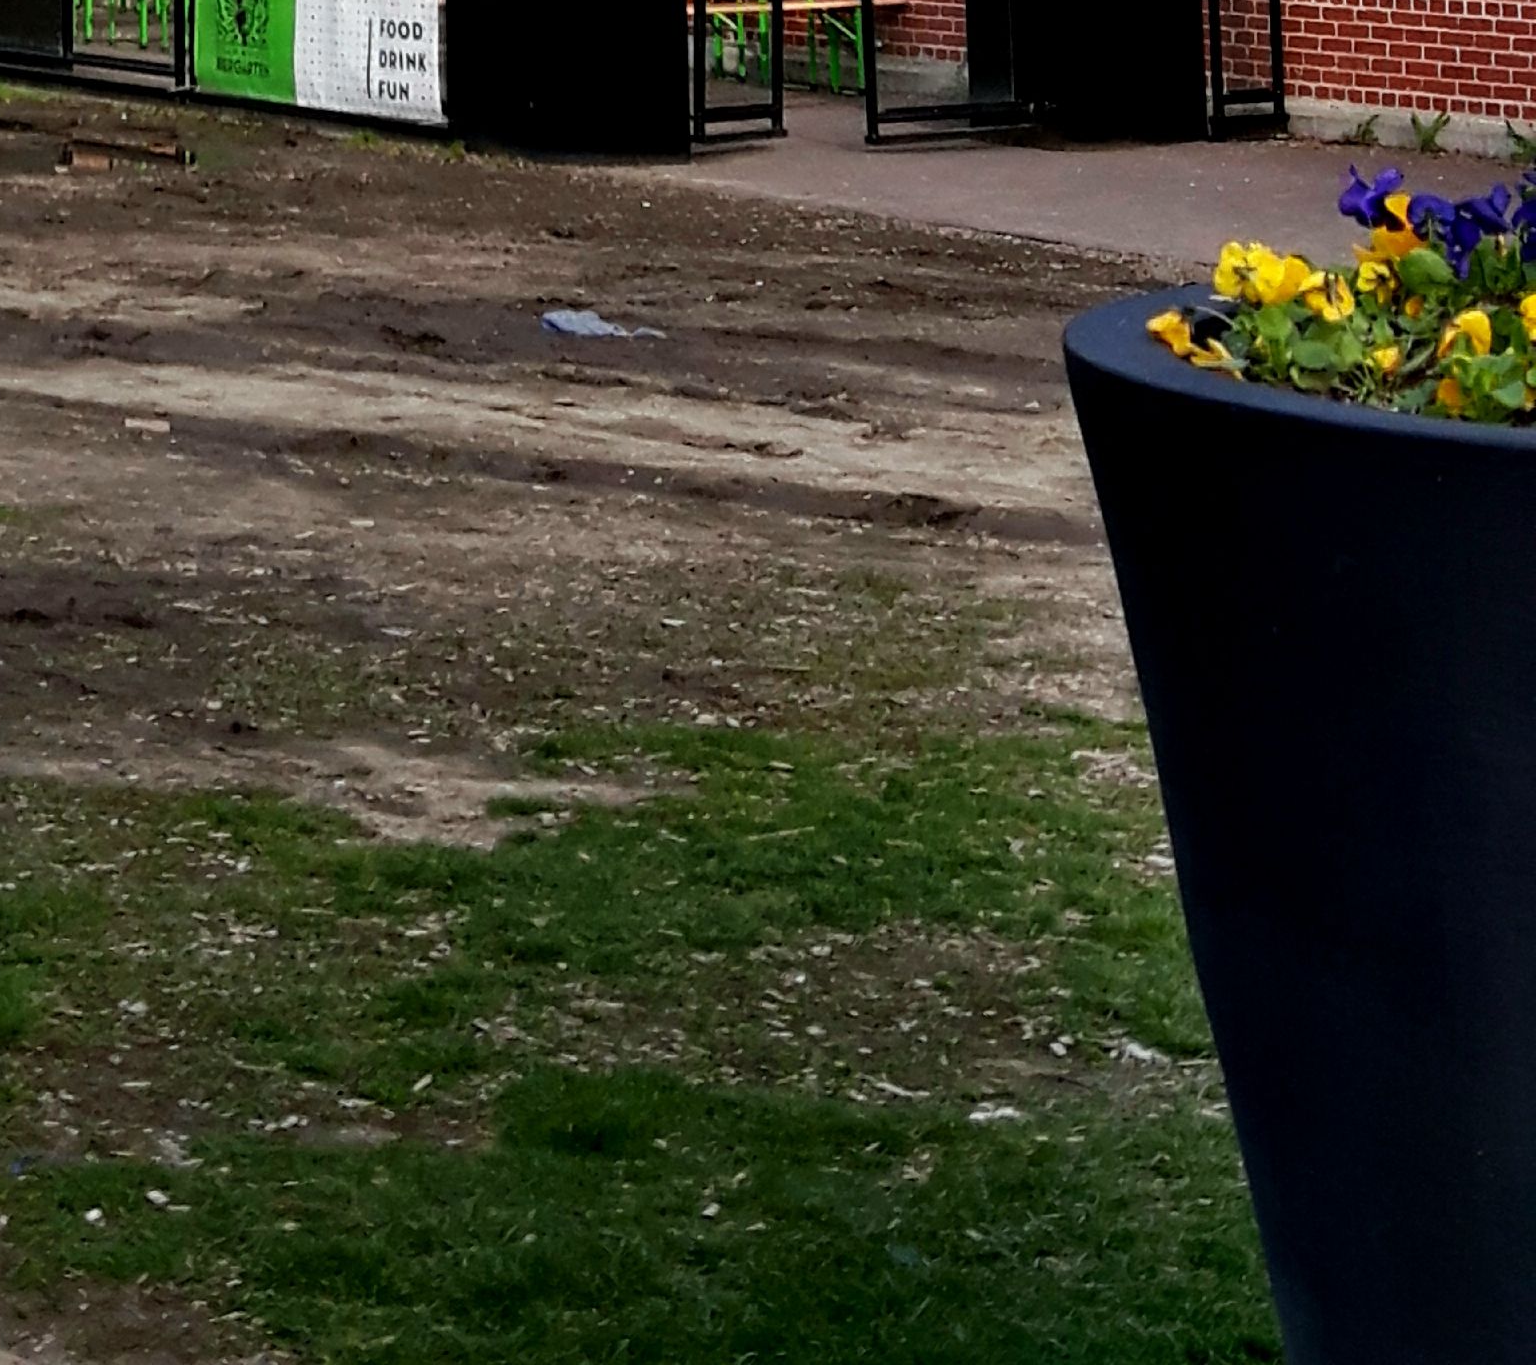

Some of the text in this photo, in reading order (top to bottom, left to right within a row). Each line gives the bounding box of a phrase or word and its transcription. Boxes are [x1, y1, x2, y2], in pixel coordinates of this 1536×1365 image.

[380, 18, 423, 40] FOOD
[379, 49, 426, 72] DRINK
[378, 79, 410, 101] FUN
